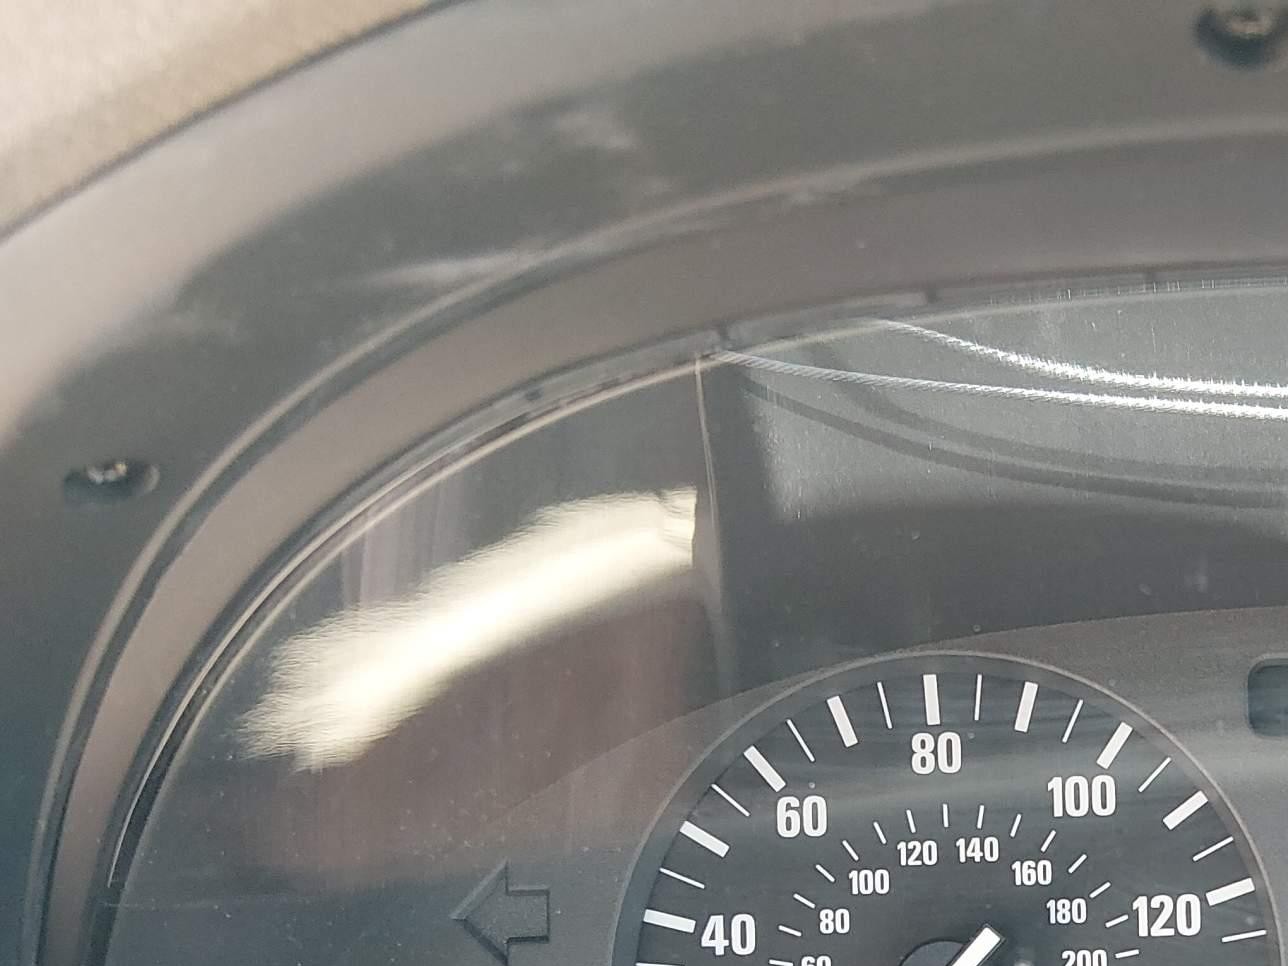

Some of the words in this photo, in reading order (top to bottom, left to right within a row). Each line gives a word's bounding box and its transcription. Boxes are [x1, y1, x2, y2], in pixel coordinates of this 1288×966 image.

[910, 732, 961, 774] 80
[1047, 775, 1116, 817] 100
[776, 795, 828, 837] 60
[897, 841, 938, 865] 120
[956, 837, 999, 862] 140
[848, 870, 889, 895] 100
[1011, 860, 1052, 886] 160
[819, 909, 850, 934] 80
[1047, 899, 1087, 924] 180
[1133, 894, 1201, 937] 120
[701, 914, 755, 956] 40
